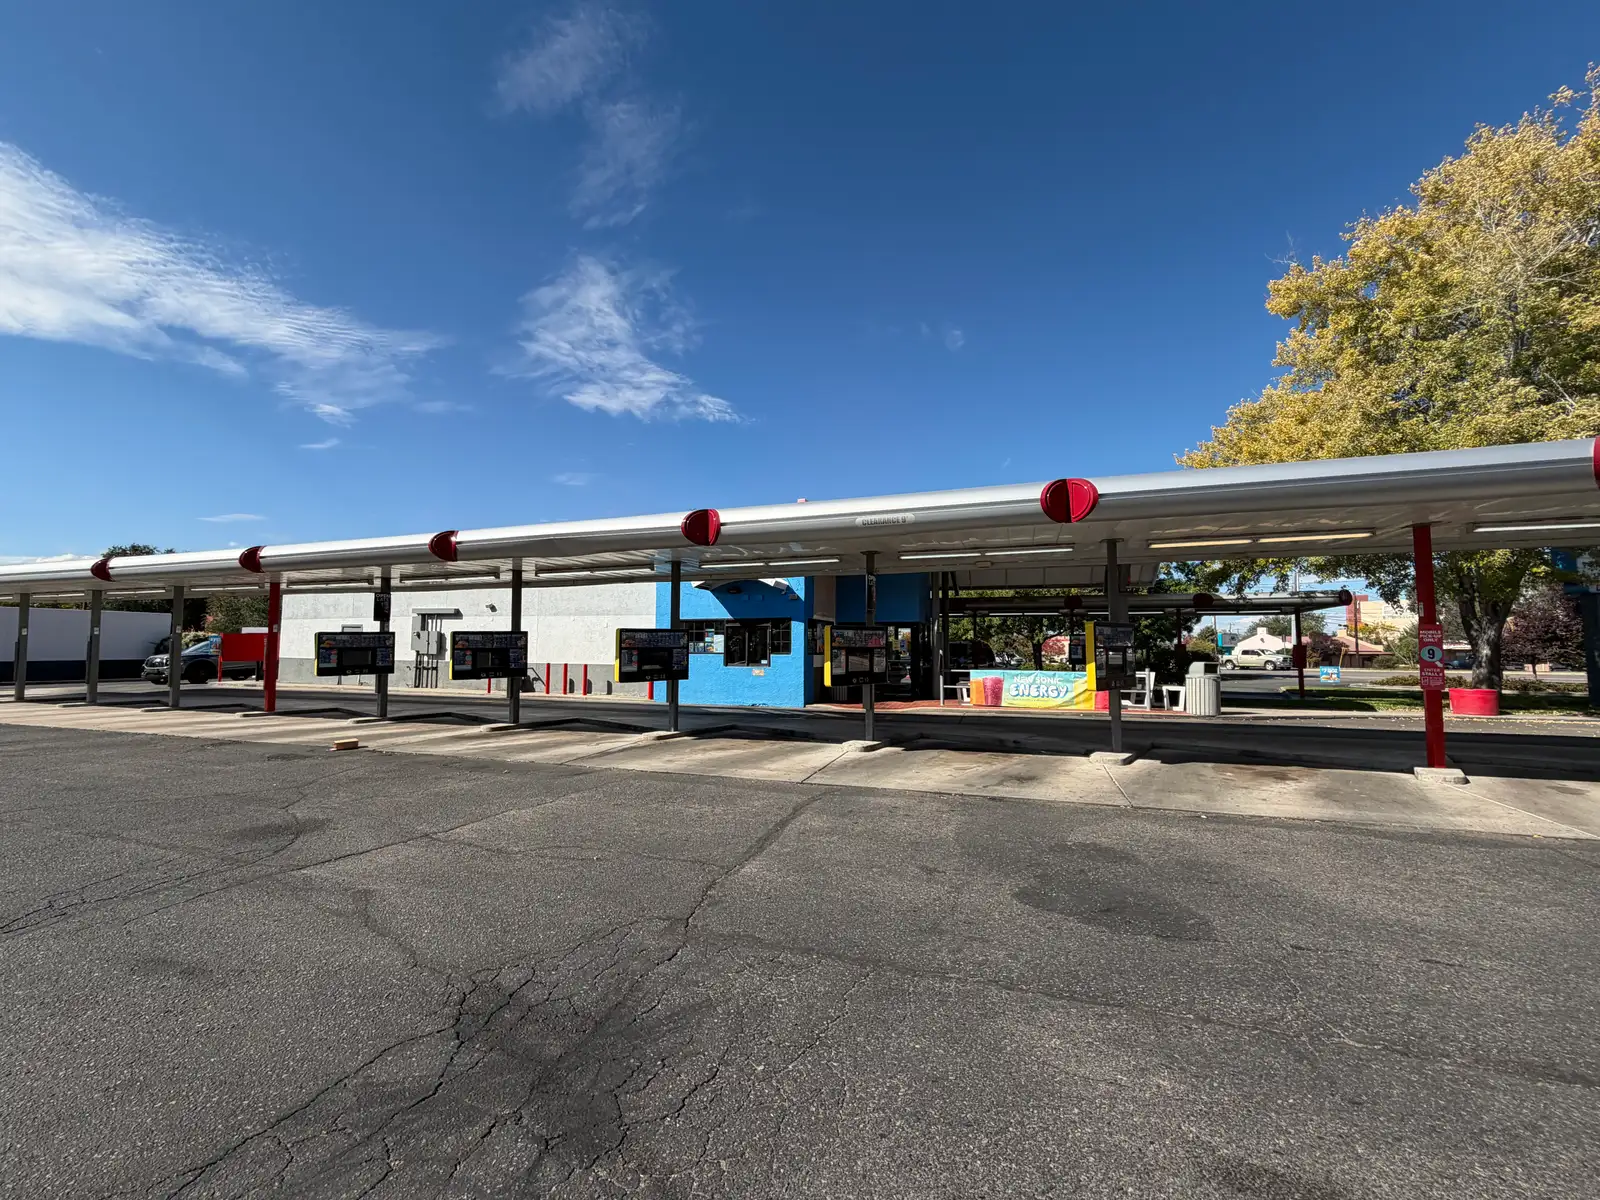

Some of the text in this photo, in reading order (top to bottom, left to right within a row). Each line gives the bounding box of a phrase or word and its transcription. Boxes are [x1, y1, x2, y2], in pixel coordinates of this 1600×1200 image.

[862, 516, 901, 525] CLEARANCE
[1428, 648, 1435, 659] 9
[1036, 676, 1062, 684] SONIC
[1009, 684, 1068, 698] ENERGY
